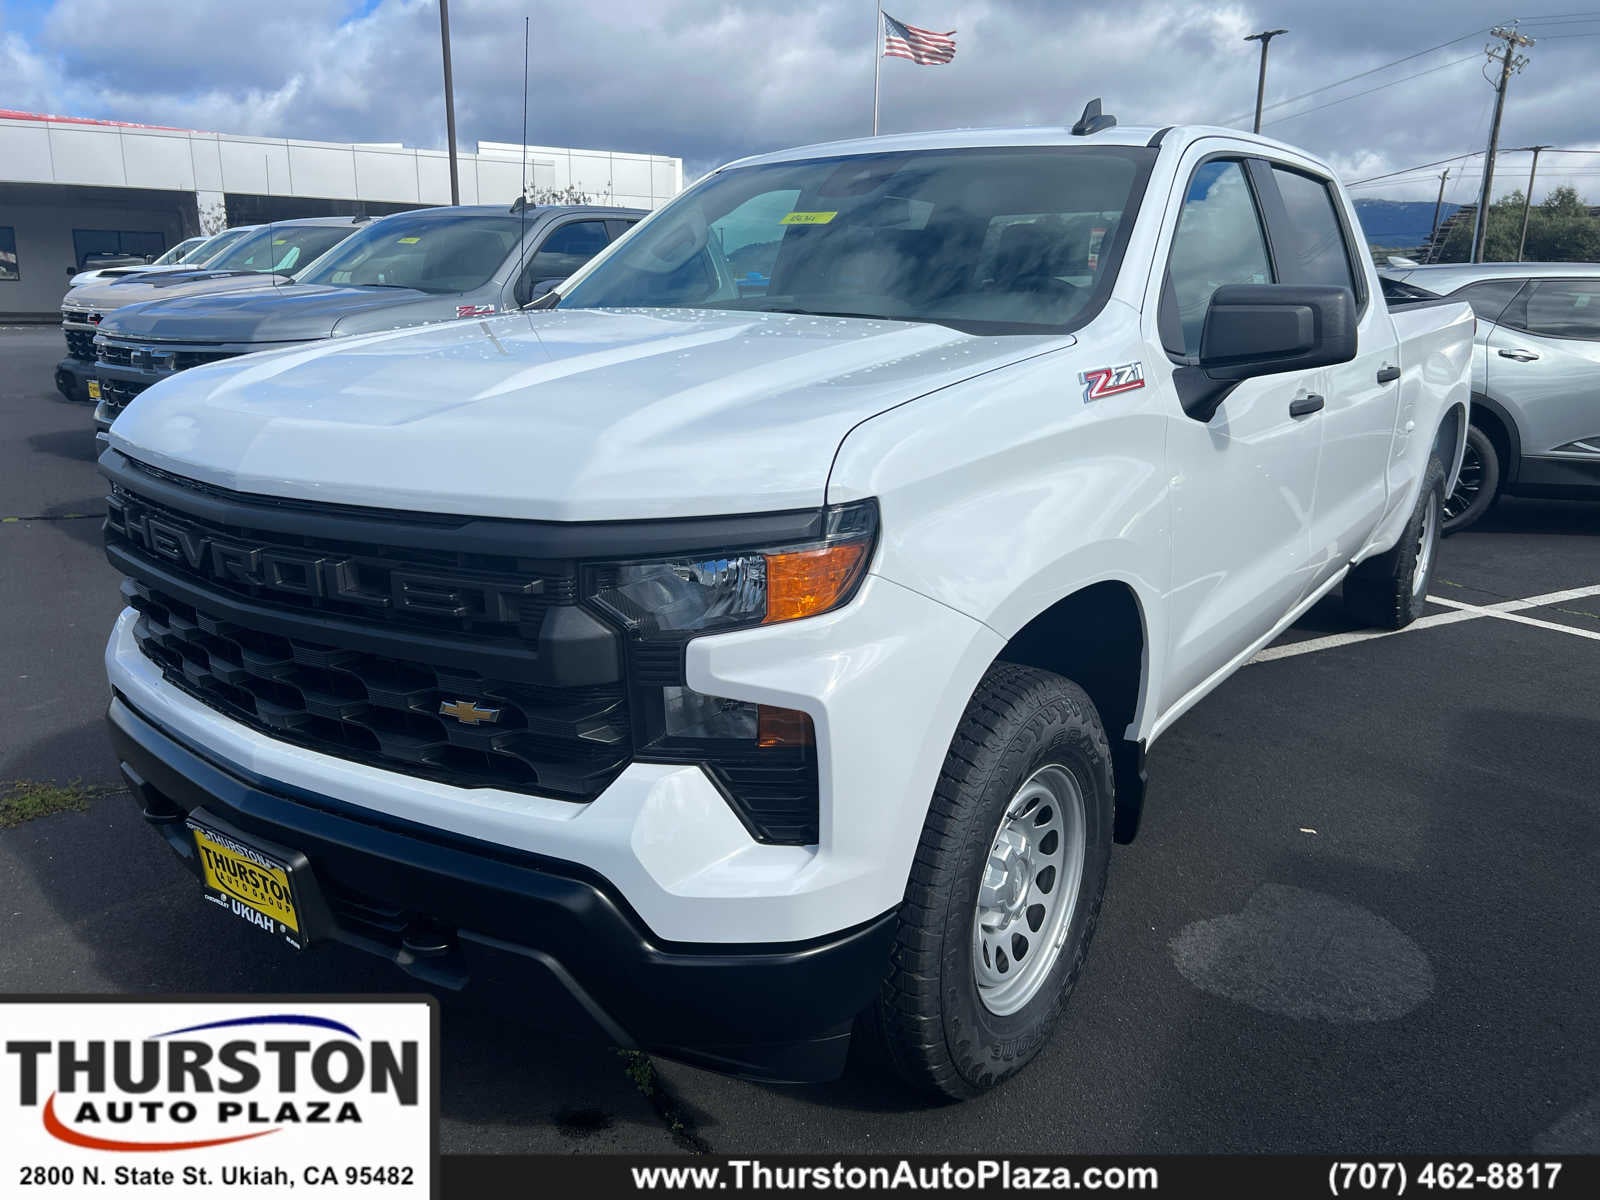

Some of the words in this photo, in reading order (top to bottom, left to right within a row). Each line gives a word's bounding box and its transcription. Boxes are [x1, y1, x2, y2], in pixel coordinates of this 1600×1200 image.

[456, 304, 495, 318] Z71
[1079, 361, 1145, 404] Z71
[105, 494, 545, 623] CHEVROLET
[208, 831, 266, 865] THURSTON
[201, 846, 292, 906] THURSTON
[220, 870, 247, 893] AUTO
[232, 900, 274, 934] UKIAH
